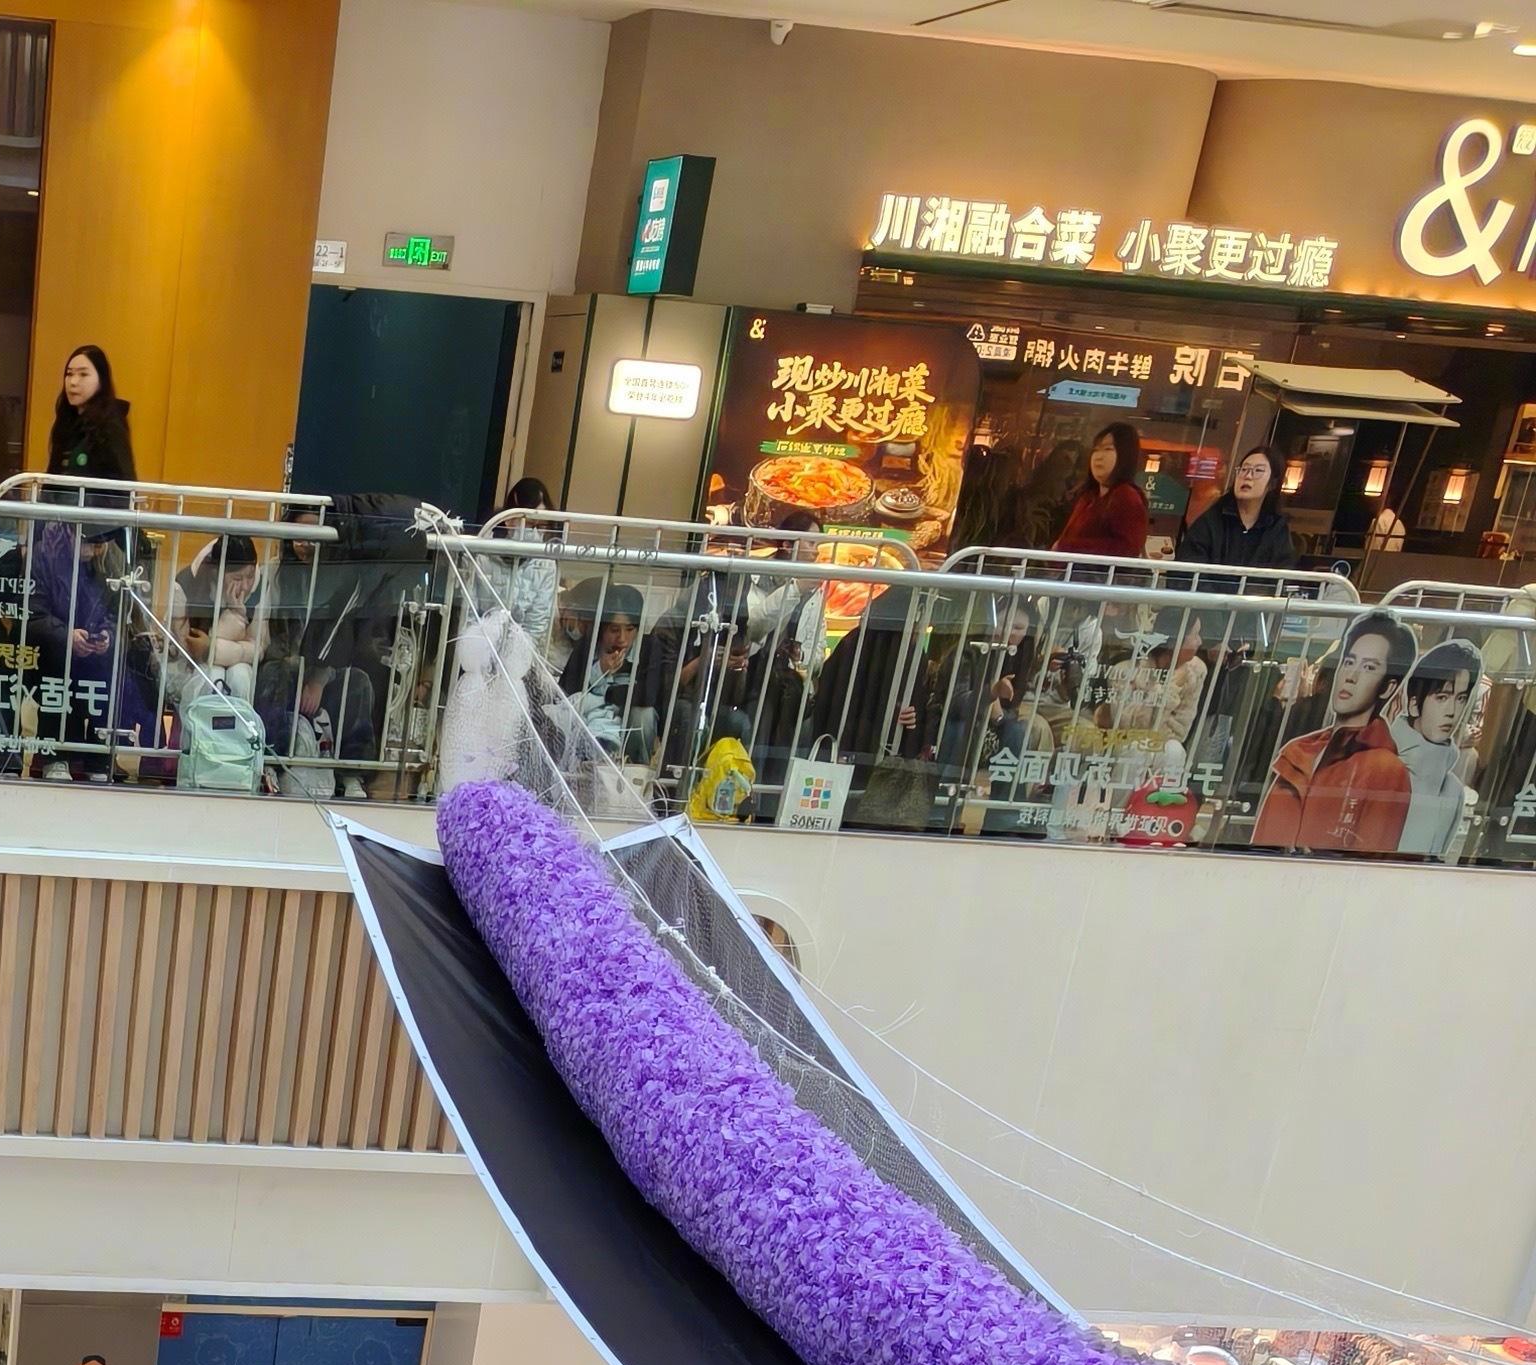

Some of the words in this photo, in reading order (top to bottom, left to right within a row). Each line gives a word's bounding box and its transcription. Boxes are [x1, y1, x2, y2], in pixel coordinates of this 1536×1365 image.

[870, 193, 1102, 266] 川湘融合菜
[1118, 219, 1340, 289] 小聚更过瘾
[771, 354, 936, 403] 现炒川湘菜
[767, 391, 929, 443] 小聚更过瘾
